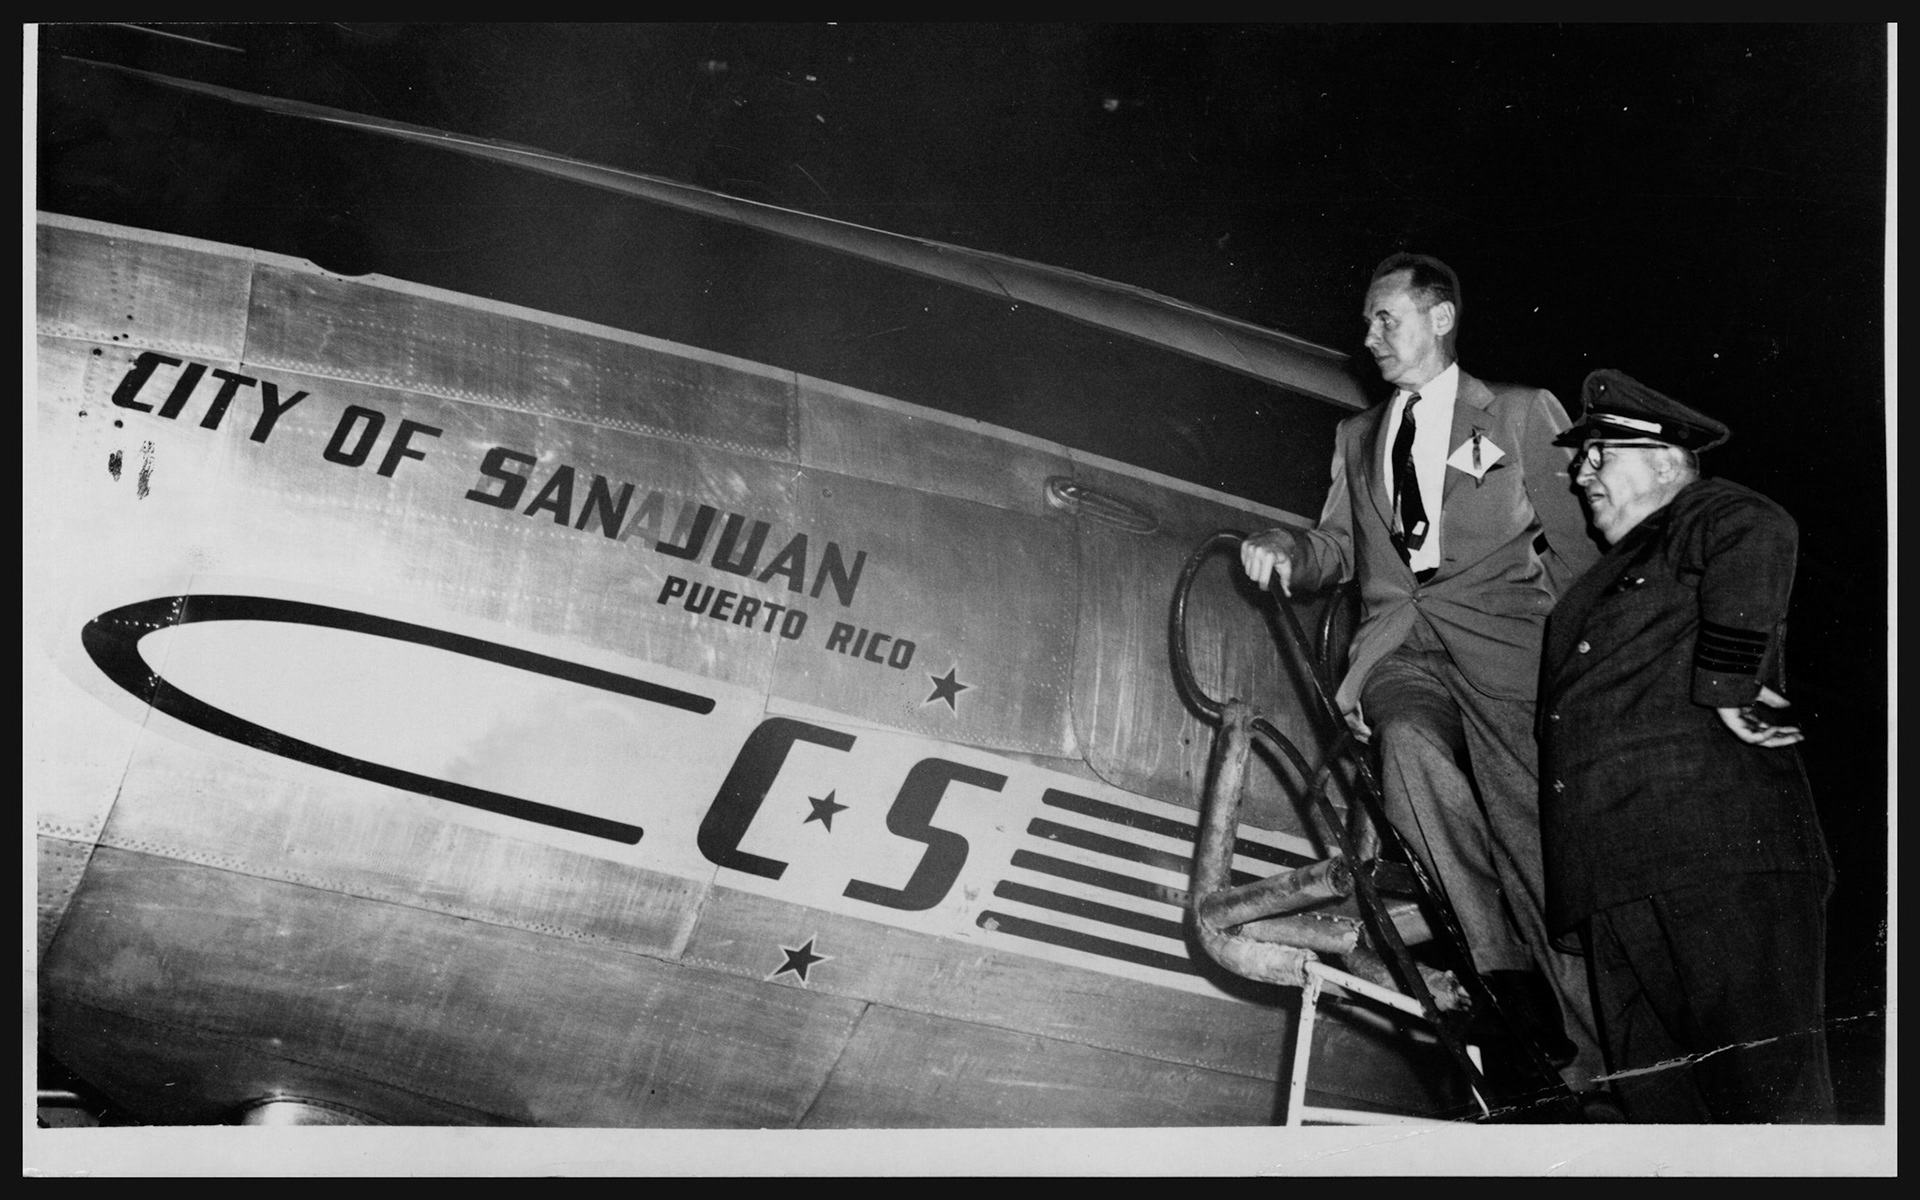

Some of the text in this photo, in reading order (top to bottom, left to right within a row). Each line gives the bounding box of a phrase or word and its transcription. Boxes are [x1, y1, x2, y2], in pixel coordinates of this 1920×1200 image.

[111, 352, 310, 444] CITY
[323, 404, 443, 478] OF
[655, 503, 867, 608] JUAN
[657, 575, 916, 670] PUERTO RICO
